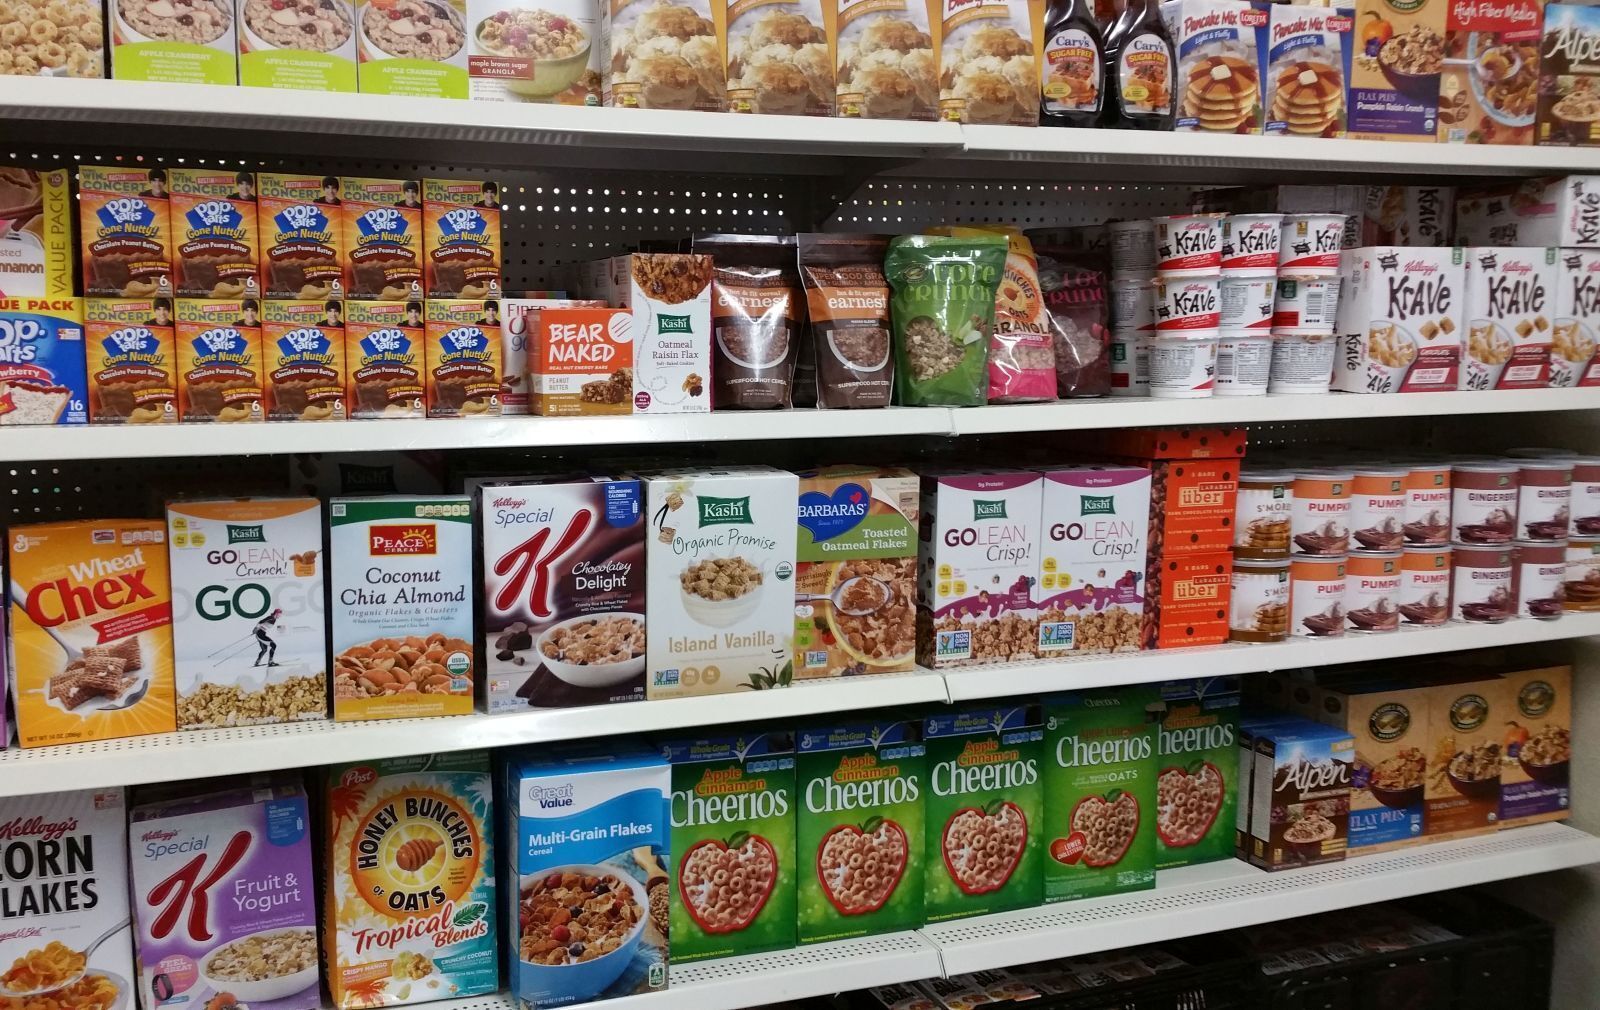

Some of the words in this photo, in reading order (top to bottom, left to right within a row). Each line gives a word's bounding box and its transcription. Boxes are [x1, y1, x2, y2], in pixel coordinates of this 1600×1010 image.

[1453, 4, 1476, 25] High
[1479, 3, 1503, 18] Fiber
[1505, 8, 1538, 25] Medley
[1184, 16, 1220, 36] Pancake
[1222, 12, 1238, 24] Mix
[1273, 23, 1306, 42] Pancake
[1308, 19, 1324, 30] Mix
[1056, 36, 1090, 49] Cary's
[1134, 41, 1164, 52] Cary's
[1050, 49, 1074, 59] SUGAR
[1076, 48, 1094, 59] FREE
[1129, 53, 1150, 62] SUGAR
[1150, 53, 1167, 62] FREE
[470, 60, 489, 69] maple
[491, 60, 510, 68] brown
[1356, 102, 1384, 112] Pumpkin
[1386, 103, 1404, 111] Raisin
[82, 171, 102, 181] WIN
[81, 181, 146, 193] CONCERT
[52, 192, 64, 234] PACK
[97, 225, 122, 237] Gone
[124, 223, 159, 237] Nutty!
[93, 241, 121, 251] Chocolate
[122, 239, 141, 247] Peanut
[143, 241, 160, 250] Butter
[52, 248, 65, 295] VALUE
[1404, 260, 1438, 275] Kellogg's
[1502, 261, 1533, 274] Kellogg's
[160, 275, 167, 287] 6
[28, 301, 74, 311] PACK
[718, 293, 789, 307] earnest
[828, 295, 886, 308] earnest
[661, 318, 687, 328] Kashi
[549, 324, 604, 343] BEAR
[658, 341, 693, 349] Oatmeal
[549, 344, 615, 363] NAKED
[652, 351, 678, 359] Raisin
[681, 351, 699, 359] Flax
[70, 400, 83, 411] 16
[492, 498, 526, 509] Kellogg's
[1182, 488, 1221, 504] über
[703, 503, 744, 518] Kashi
[977, 504, 1002, 515] Kashi
[1084, 499, 1110, 510] Kashi
[495, 508, 554, 528] Special
[232, 527, 260, 539] Kashi
[862, 527, 907, 538] Toasted
[944, 524, 1026, 547] GOLEAN
[1050, 520, 1134, 542] GOLEAN
[373, 536, 424, 549] PEACE
[672, 533, 724, 557] Organic
[728, 528, 776, 551] Promise
[822, 542, 870, 551] Oatmeal
[873, 539, 907, 550] Flakes
[1092, 539, 1139, 560] Crisp!
[207, 548, 285, 565] GOLEAN
[986, 543, 1032, 565] Crisp!
[68, 546, 147, 583] Wheat
[236, 562, 288, 577] Crunch!
[494, 508, 592, 618] K
[571, 560, 632, 578] Chocolatey
[366, 567, 441, 585] Coconut
[576, 573, 627, 591] Delight
[340, 588, 387, 606] Chia
[393, 585, 465, 604] Almond
[1177, 582, 1215, 597] über
[25, 568, 157, 628] Chex
[195, 583, 272, 622] GO
[348, 609, 382, 618] Organic
[386, 607, 412, 616] Flakes
[425, 606, 458, 614] Clusters
[668, 634, 718, 653] Island
[725, 631, 775, 649] Vanilla
[963, 739, 999, 756] Apple
[1056, 735, 1151, 769] Cheerios
[841, 755, 877, 770] Apple
[957, 750, 1019, 766] Cinnamon
[346, 770, 372, 784] Post
[702, 767, 742, 783] Apple
[833, 766, 899, 783] Cinnamon
[931, 758, 1038, 797] Cheerios
[1108, 770, 1138, 782] OATS
[1275, 762, 1350, 793] Alpen
[528, 783, 573, 802] Great
[695, 778, 766, 796] Cinnamon
[805, 775, 919, 814] Cheerios
[539, 798, 573, 809] Value
[670, 788, 788, 828] Cheerios
[1350, 812, 1378, 828] FLAX
[1379, 809, 1407, 824] PLUS
[0, 816, 78, 841] Kellogg's
[141, 829, 179, 842] Kellogg's
[358, 803, 400, 871] HONEY
[405, 797, 473, 859] BUNCHES
[528, 826, 608, 848] Multi-Grain
[610, 822, 652, 837] Flakes
[144, 834, 209, 861] Special
[528, 847, 553, 856] Cereal
[1063, 839, 1082, 851] LOWER
[0, 835, 94, 881] ORN
[147, 830, 252, 942] K
[235, 875, 282, 896] Fruit
[284, 872, 298, 887] &
[233, 888, 301, 912] Yogurt
[373, 885, 385, 896] OF
[388, 885, 447, 912] OATS
[351, 900, 454, 955] Tropical
[431, 921, 488, 949] Blends
[160, 959, 186, 968] FEEL
[441, 956, 466, 965] CRUNCHY
[467, 950, 493, 960] COCONUT
[163, 964, 193, 973] GREAT
[343, 966, 364, 976] CRISPY
[365, 962, 388, 971] MANGO
